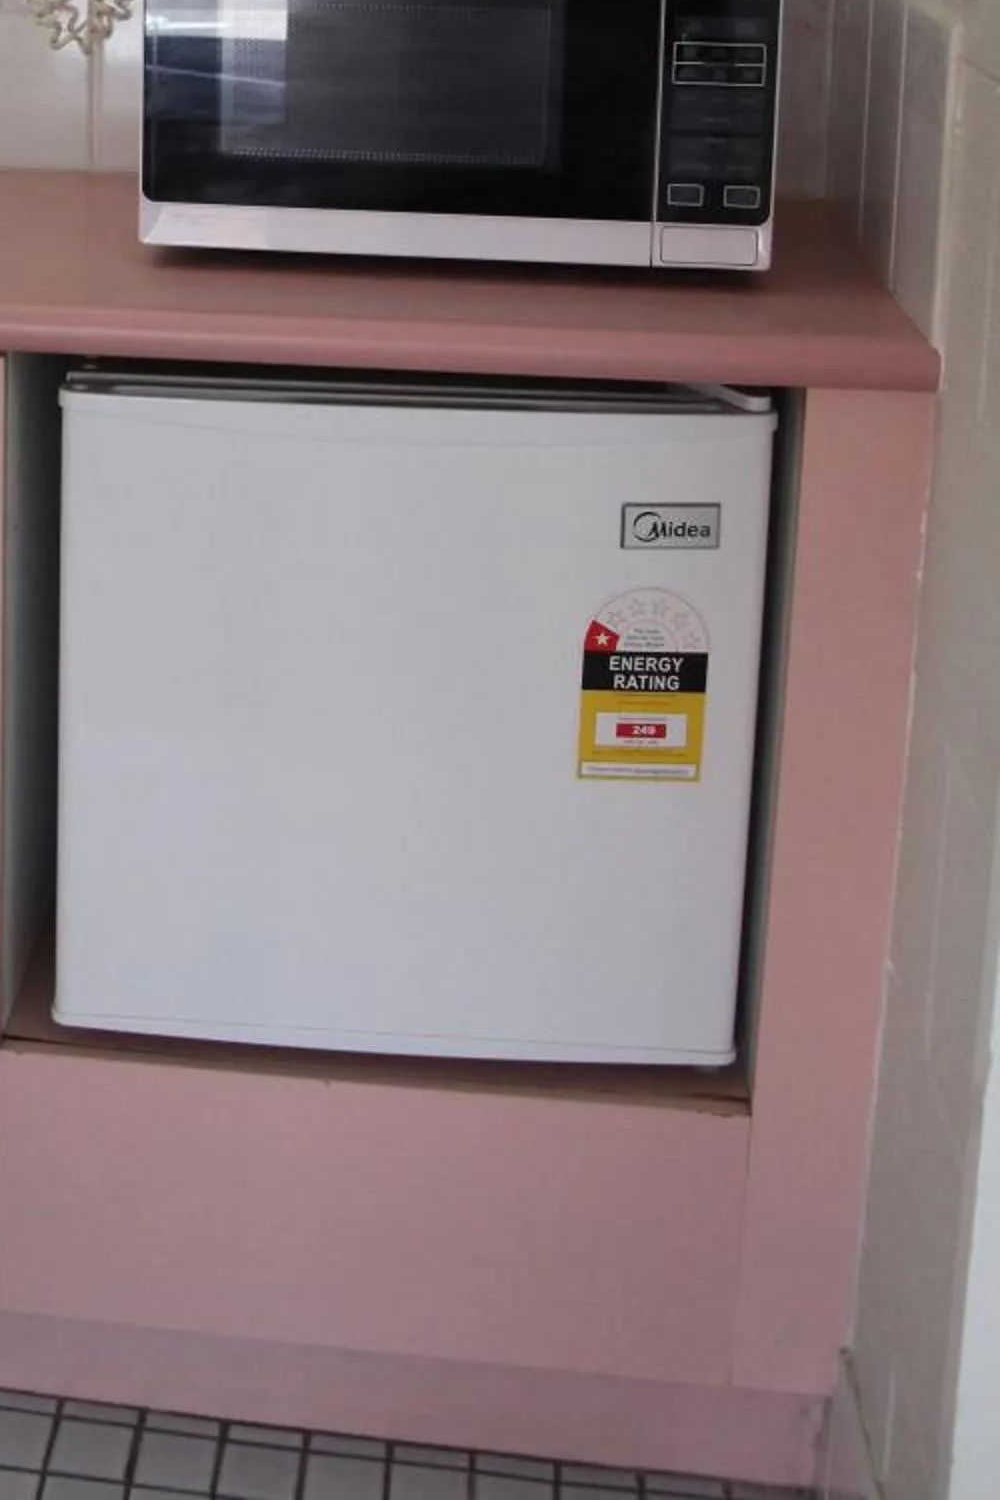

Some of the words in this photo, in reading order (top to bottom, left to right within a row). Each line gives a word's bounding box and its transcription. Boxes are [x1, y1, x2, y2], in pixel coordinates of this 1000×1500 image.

[632, 511, 711, 543] Midea
[608, 655, 684, 673] ENERGY
[613, 674, 681, 691] RATING
